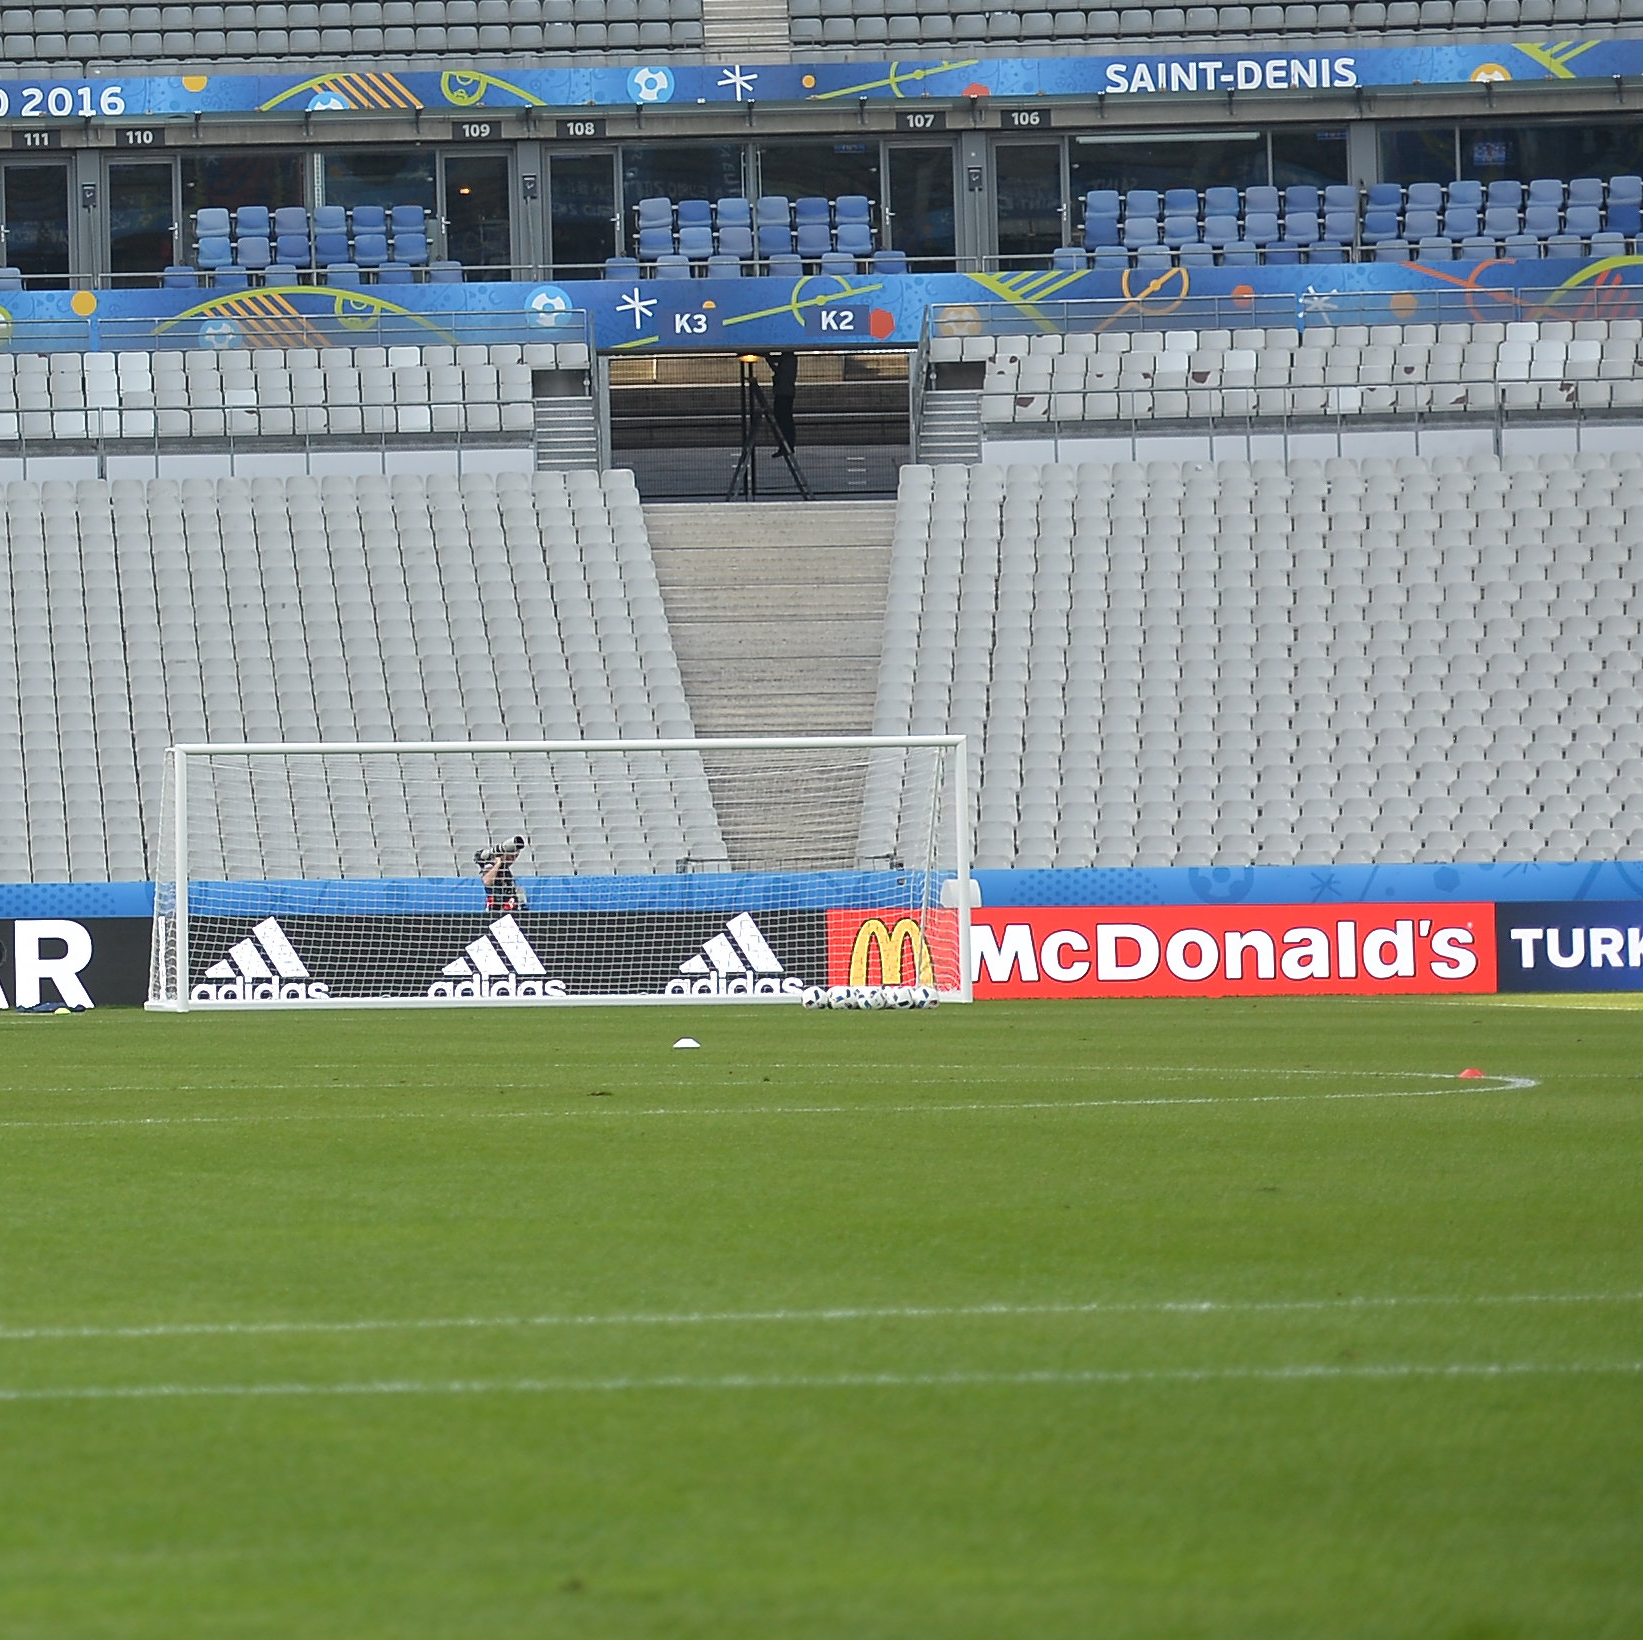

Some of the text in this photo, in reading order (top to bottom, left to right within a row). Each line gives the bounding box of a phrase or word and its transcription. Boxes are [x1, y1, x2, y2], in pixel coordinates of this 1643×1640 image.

[1106, 58, 1356, 93] SAINT-DENIS
[22, 87, 124, 117] 2016
[567, 123, 594, 135] 108
[907, 115, 934, 127] 107
[1012, 112, 1039, 125] 106
[25, 133, 48, 146] 111
[126, 131, 152, 144] 110
[463, 124, 490, 137] 109
[675, 311, 853, 333] K3 K2
[972, 919, 1477, 983] McDonald's
[191, 976, 329, 1001] adidas
[429, 974, 566, 998] adidas
[666, 971, 803, 996] adidas
